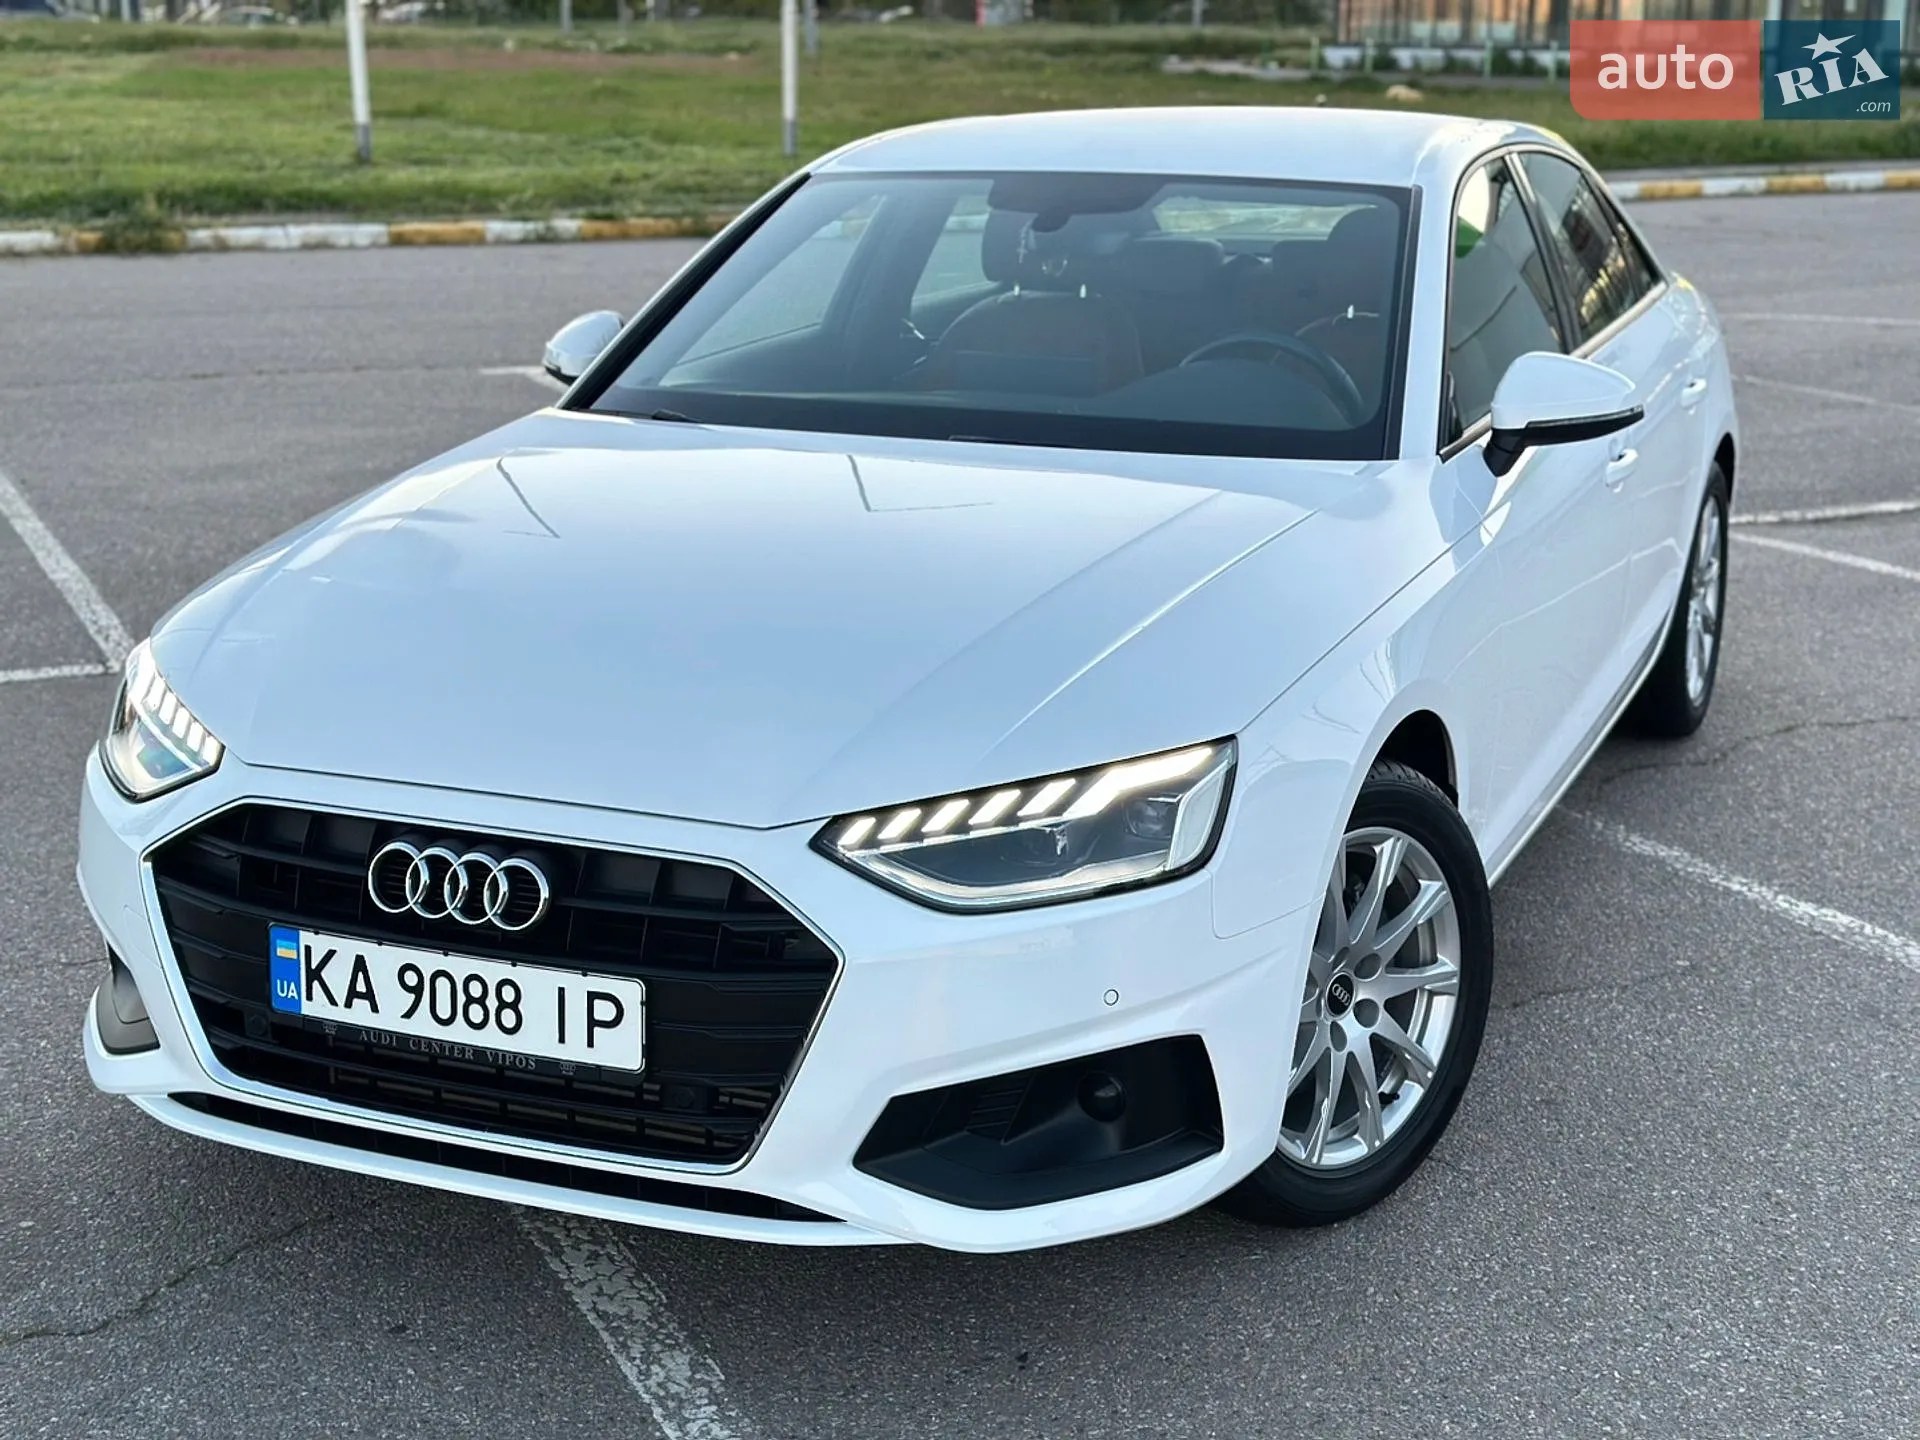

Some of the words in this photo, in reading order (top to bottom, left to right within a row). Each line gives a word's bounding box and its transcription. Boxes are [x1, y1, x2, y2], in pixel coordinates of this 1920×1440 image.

[276, 980, 299, 1000] UA
[303, 944, 380, 1014] KA
[397, 962, 523, 1036] 9088
[557, 986, 624, 1049] IP
[359, 1029, 399, 1047] AUDI
[408, 1038, 476, 1061] CENTER
[485, 1050, 537, 1070] VIPOS
